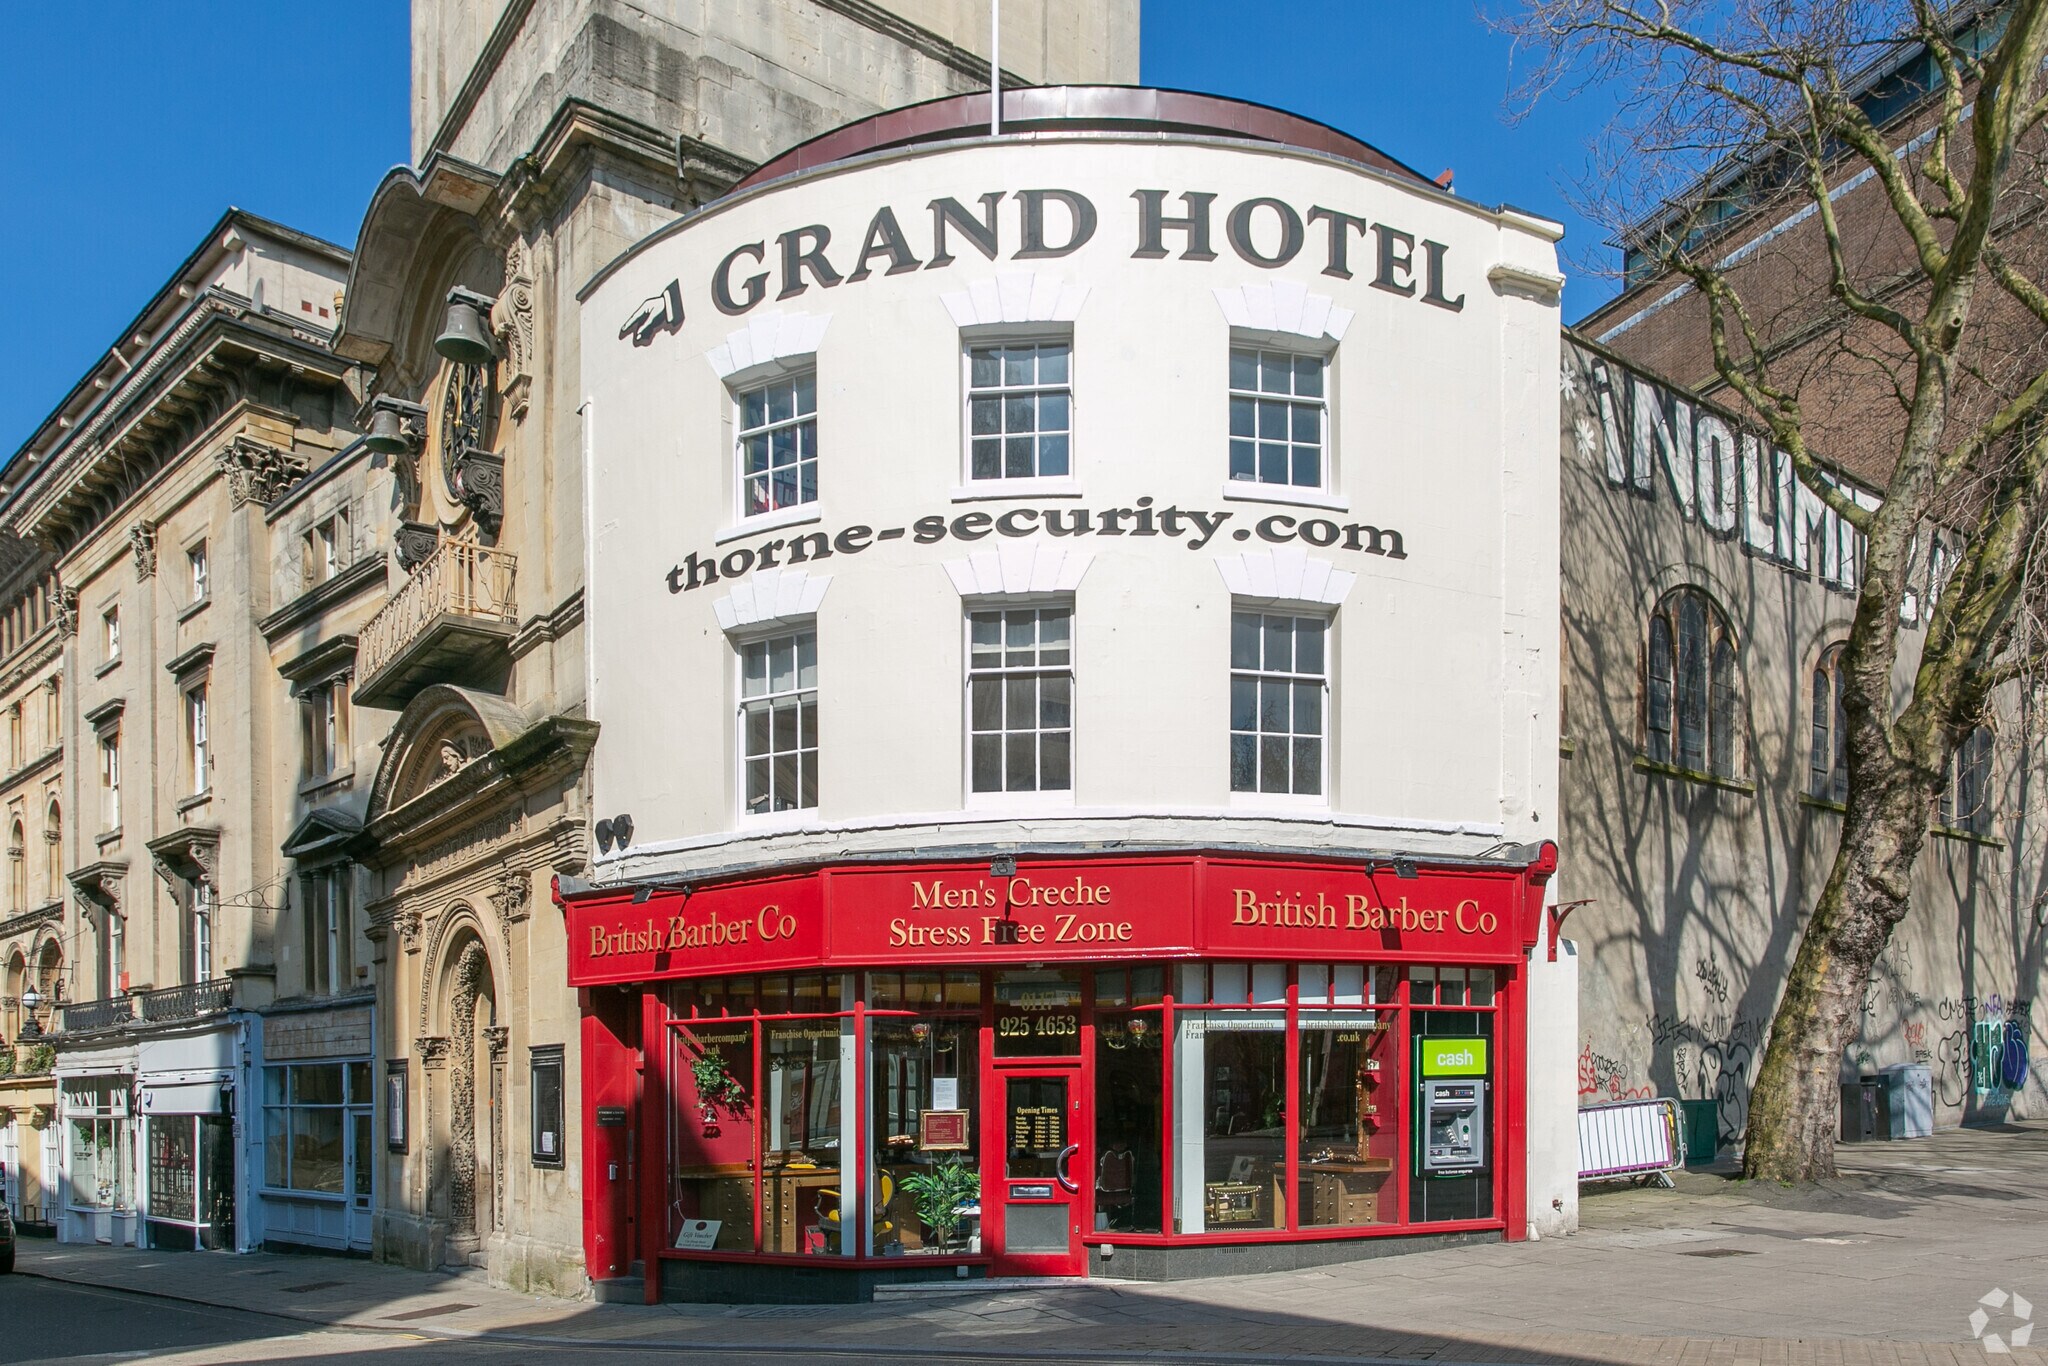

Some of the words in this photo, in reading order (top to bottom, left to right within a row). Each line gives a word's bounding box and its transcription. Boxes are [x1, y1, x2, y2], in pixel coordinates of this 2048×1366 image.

[711, 189, 1098, 316] GRAND
[1129, 189, 1465, 313] HOTEL
[665, 496, 1408, 595] thorne-security.com
[911, 879, 997, 909] Men's
[1008, 876, 1111, 907] Creche
[1232, 889, 1338, 928] British
[1345, 894, 1449, 932] Barber
[1455, 899, 1498, 935] Co
[589, 919, 662, 957] British
[668, 911, 753, 949] Barber
[757, 904, 797, 941] Co
[889, 917, 971, 947] Stress
[980, 916, 1046, 945] Free
[1055, 914, 1132, 943] Zone
[1021, 992, 1054, 1012] 0117
[771, 1029, 802, 1039] Franchise
[1000, 1016, 1030, 1037] 925
[1035, 1014, 1077, 1036] 4653
[1186, 1019, 1225, 1030] Franchise
[1227, 1019, 1274, 1031] Opportunity
[1337, 1031, 1361, 1042] .co.uk
[1437, 1049, 1474, 1067] cash
[1435, 1089, 1450, 1097] cash
[1016, 1106, 1041, 1115] Opening
[1041, 1106, 1059, 1114] Times
